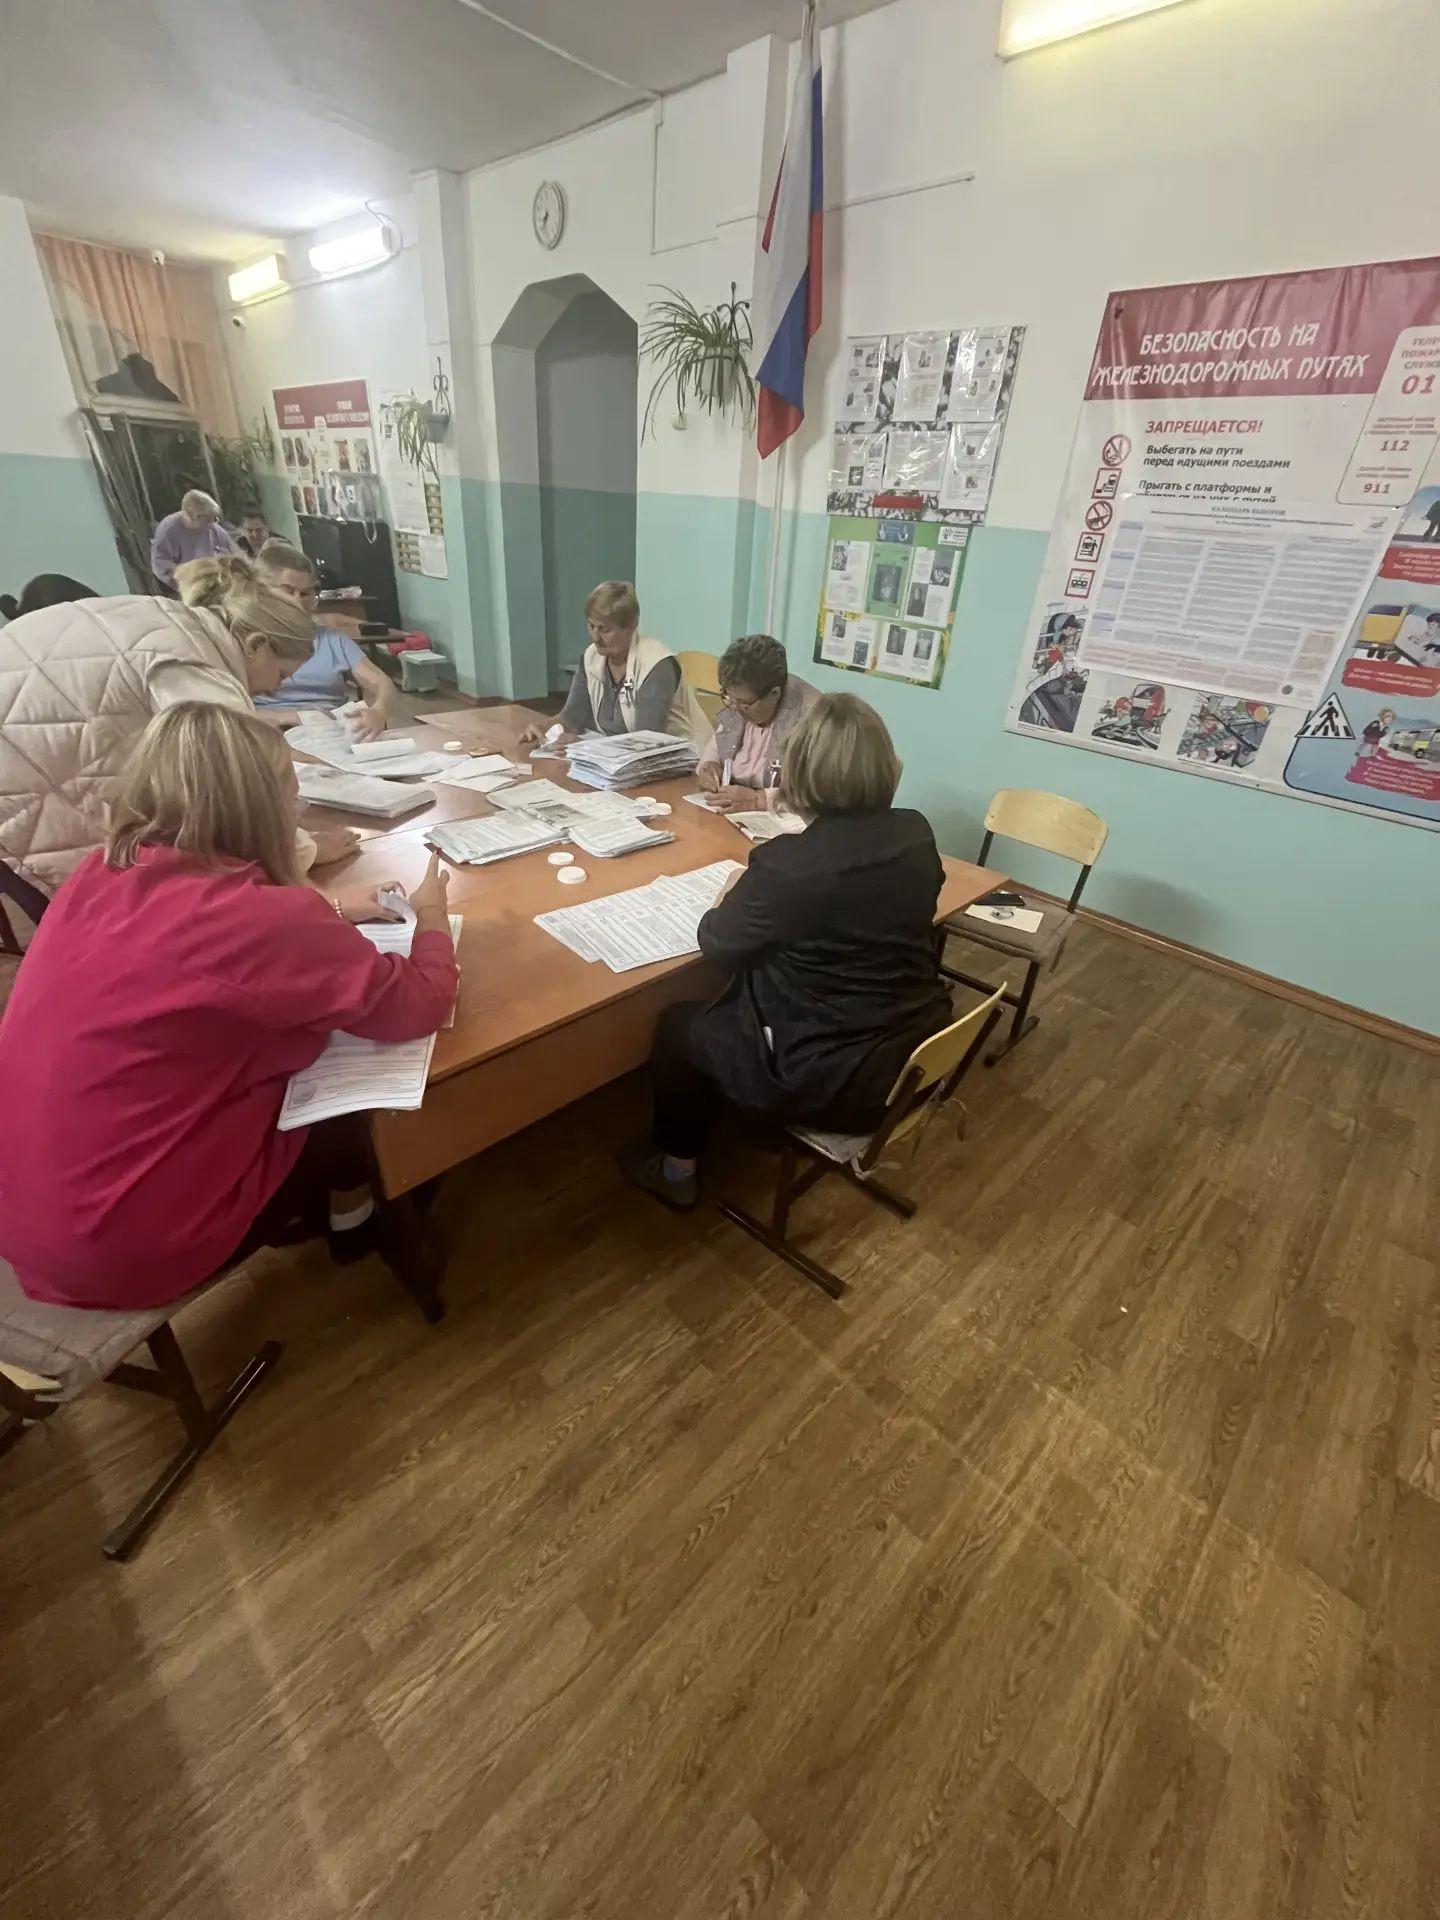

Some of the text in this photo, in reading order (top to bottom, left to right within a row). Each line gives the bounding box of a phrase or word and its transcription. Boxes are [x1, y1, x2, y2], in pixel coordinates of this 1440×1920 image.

[1140, 322, 1320, 355] БЕЗОПАСНОСТЬ НА
[1093, 354, 1370, 386] ЖЕЛЕЗНОДОРОЖНЫХ ПУТЯХ
[1402, 374, 1436, 395] 01
[1145, 420, 1264, 435] ЗАПРЕЩАЕТСЯ!
[1146, 445, 1243, 457] Выбегать на пути
[1380, 440, 1410, 451] 112
[1143, 457, 1291, 468] перед идущими поездами
[1138, 480, 1272, 494] Прыгать с платформы и
[1363, 482, 1391, 494] 911
